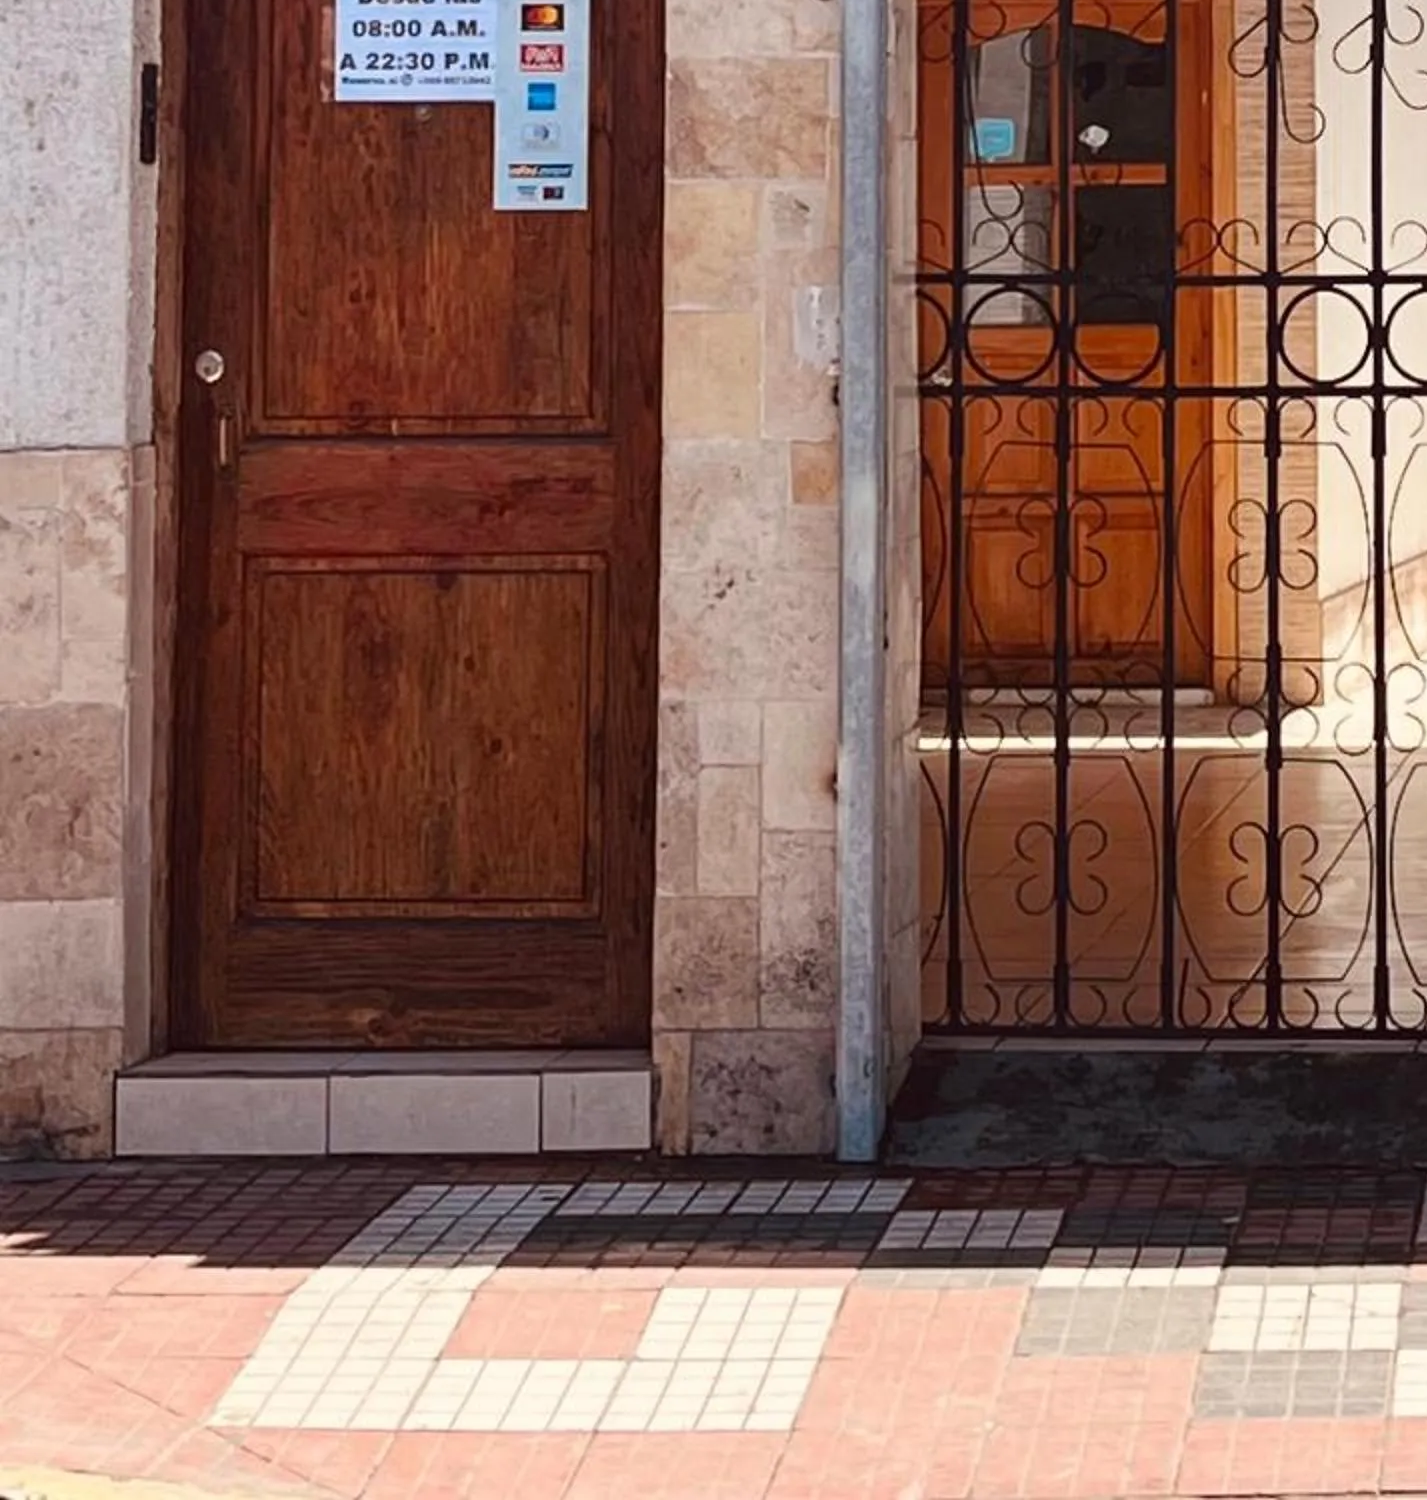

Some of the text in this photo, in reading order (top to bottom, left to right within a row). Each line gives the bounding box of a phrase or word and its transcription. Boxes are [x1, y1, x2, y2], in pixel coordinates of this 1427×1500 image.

[352, 19, 487, 38] 08:00 A.M.
[339, 52, 357, 71] A
[364, 52, 435, 71] 22:30
